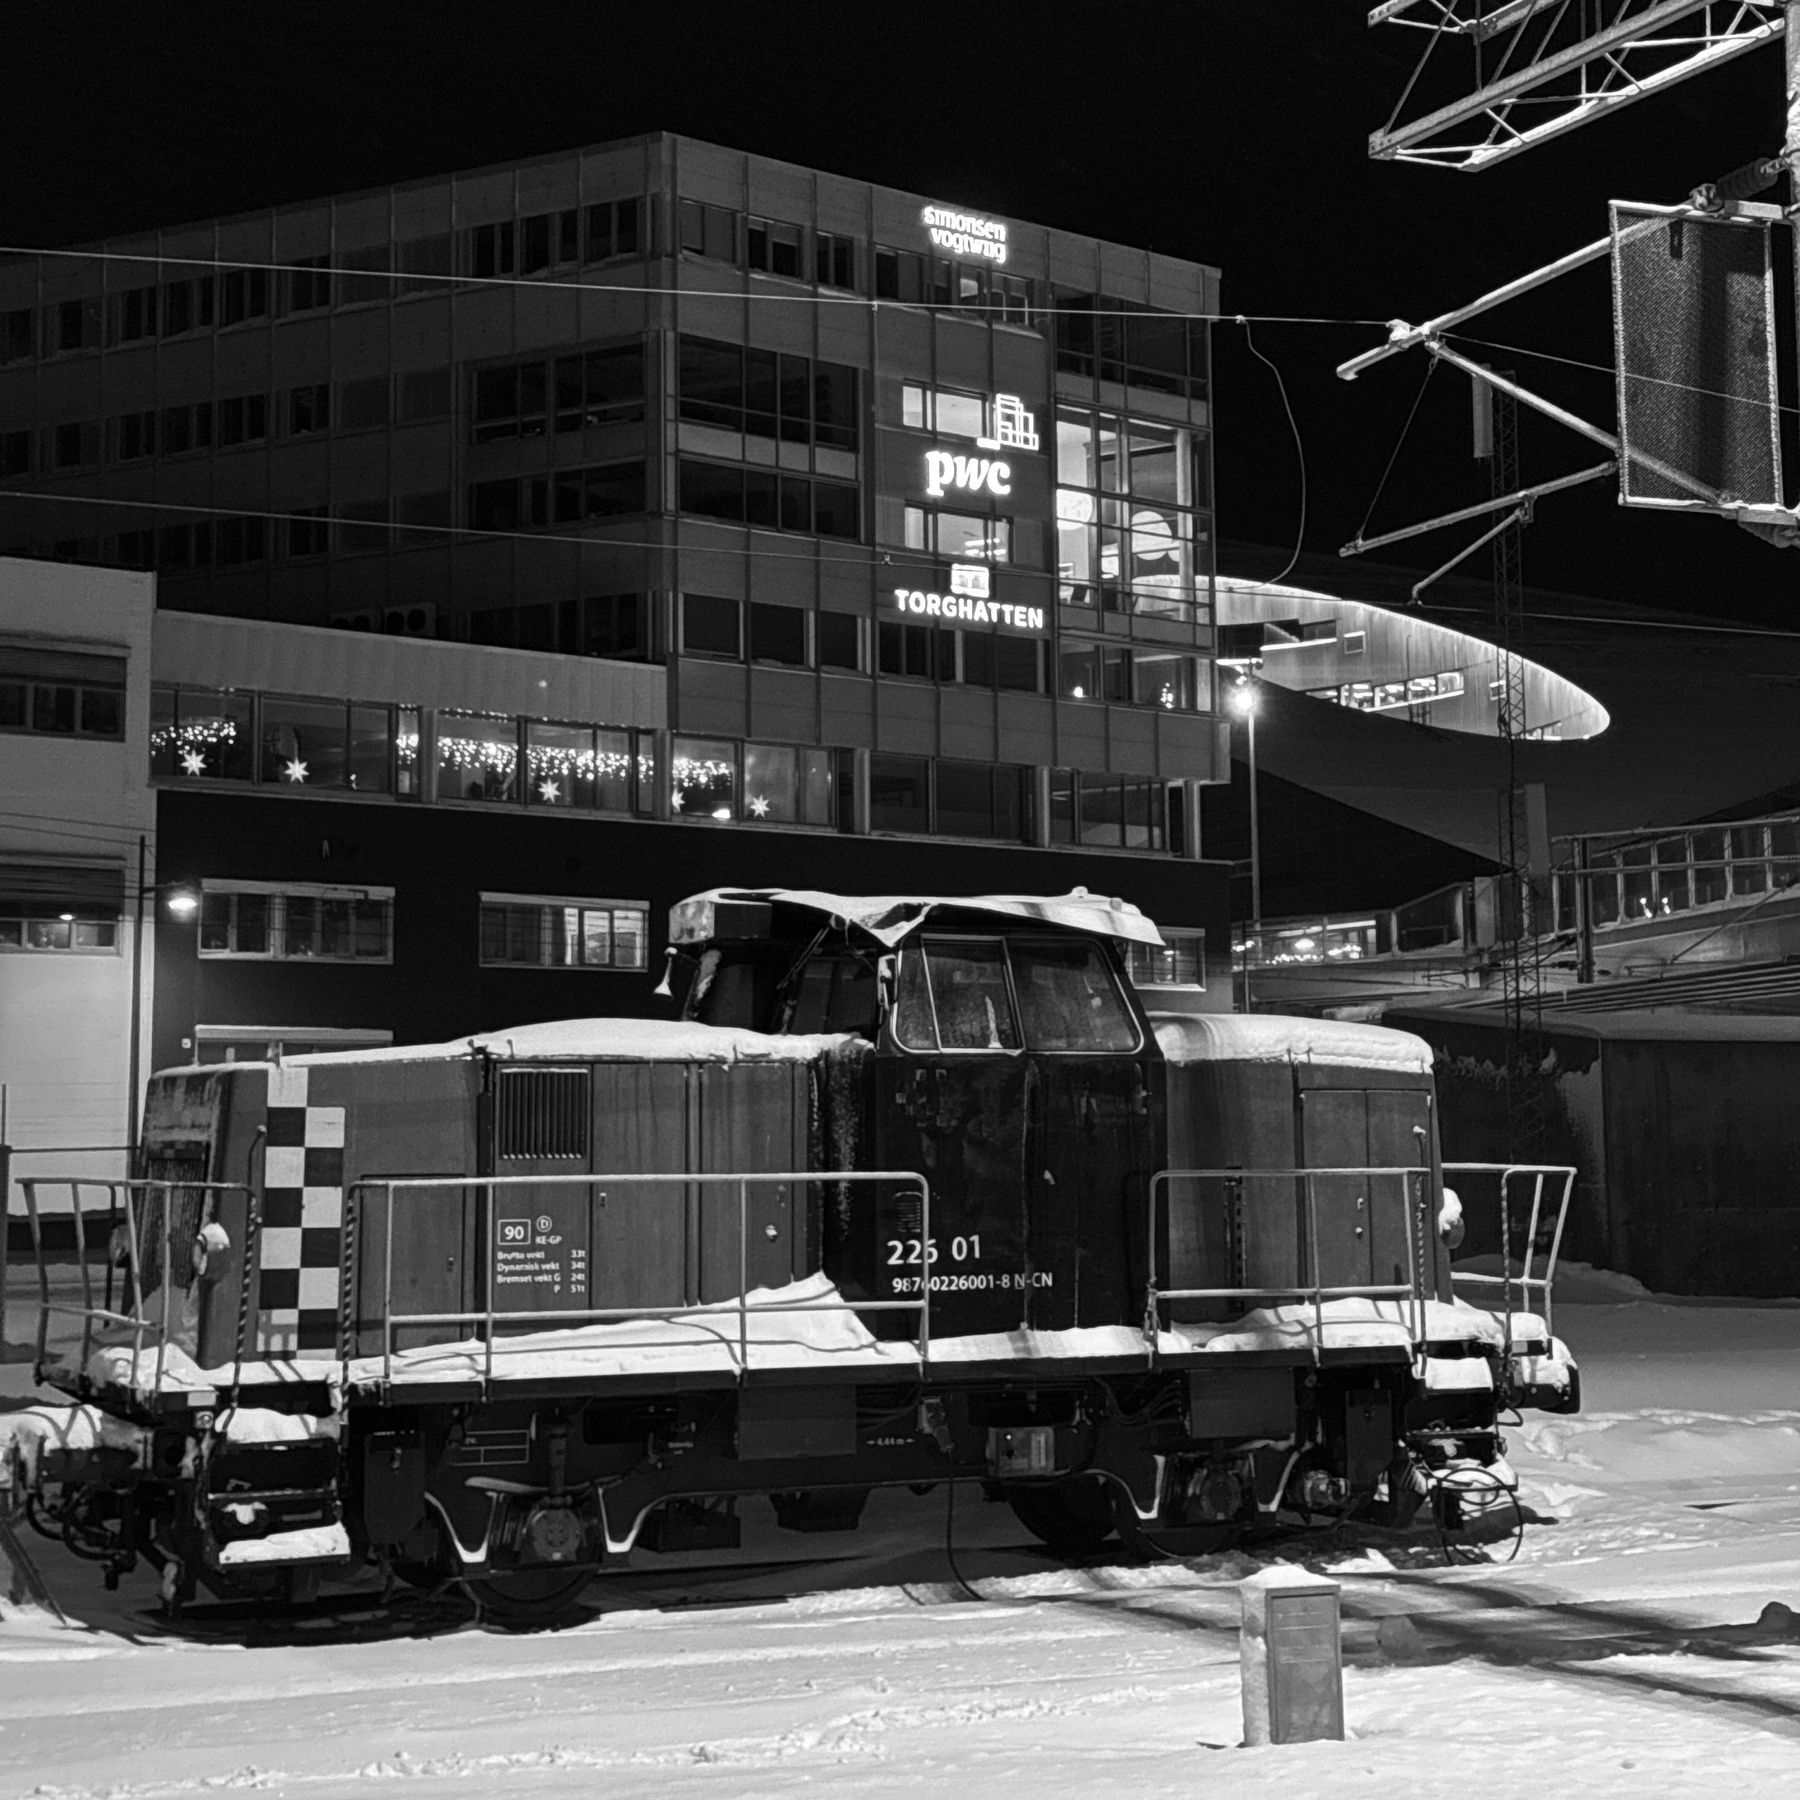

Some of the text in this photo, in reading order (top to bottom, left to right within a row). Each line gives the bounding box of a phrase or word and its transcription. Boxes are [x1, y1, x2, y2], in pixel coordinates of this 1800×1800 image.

[924, 206, 1006, 241] simonsen
[925, 450, 1012, 496] pwc
[894, 589, 1044, 629] TORGHATTEN
[504, 1225, 525, 1240] 90
[535, 1235, 562, 1245] KE-GP
[951, 1234, 981, 1261] 01
[553, 1273, 562, 1282] G
